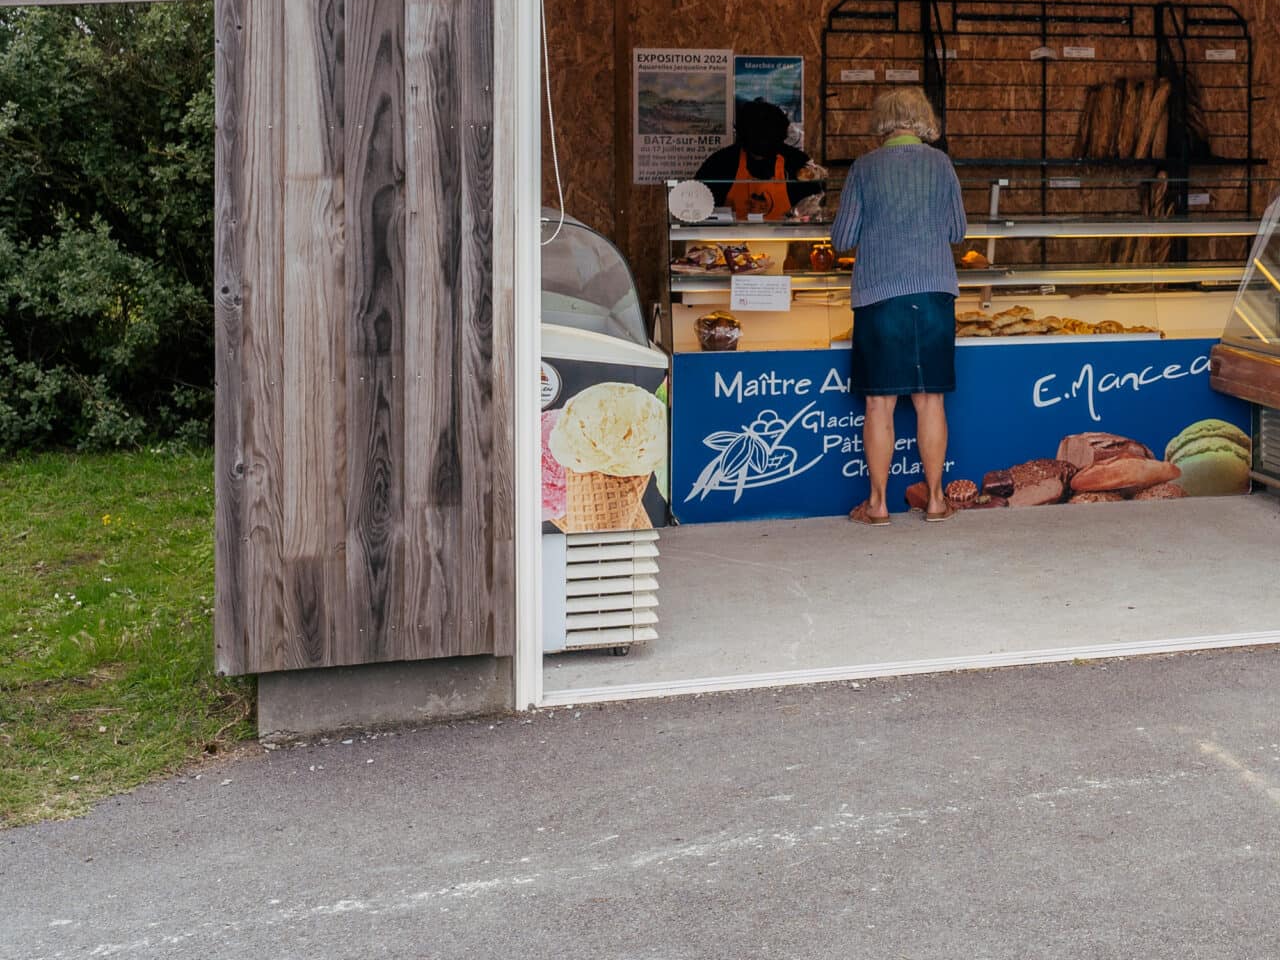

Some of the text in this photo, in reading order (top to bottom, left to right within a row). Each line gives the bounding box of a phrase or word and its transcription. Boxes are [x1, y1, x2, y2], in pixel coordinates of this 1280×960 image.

[637, 54, 729, 64] EXPOSITION 2024
[662, 145, 685, 154] juillet
[714, 369, 813, 404] Maître
[1032, 354, 1212, 422] E.Mancea
[801, 410, 865, 433] Glacie
[823, 433, 917, 454] Pâter
